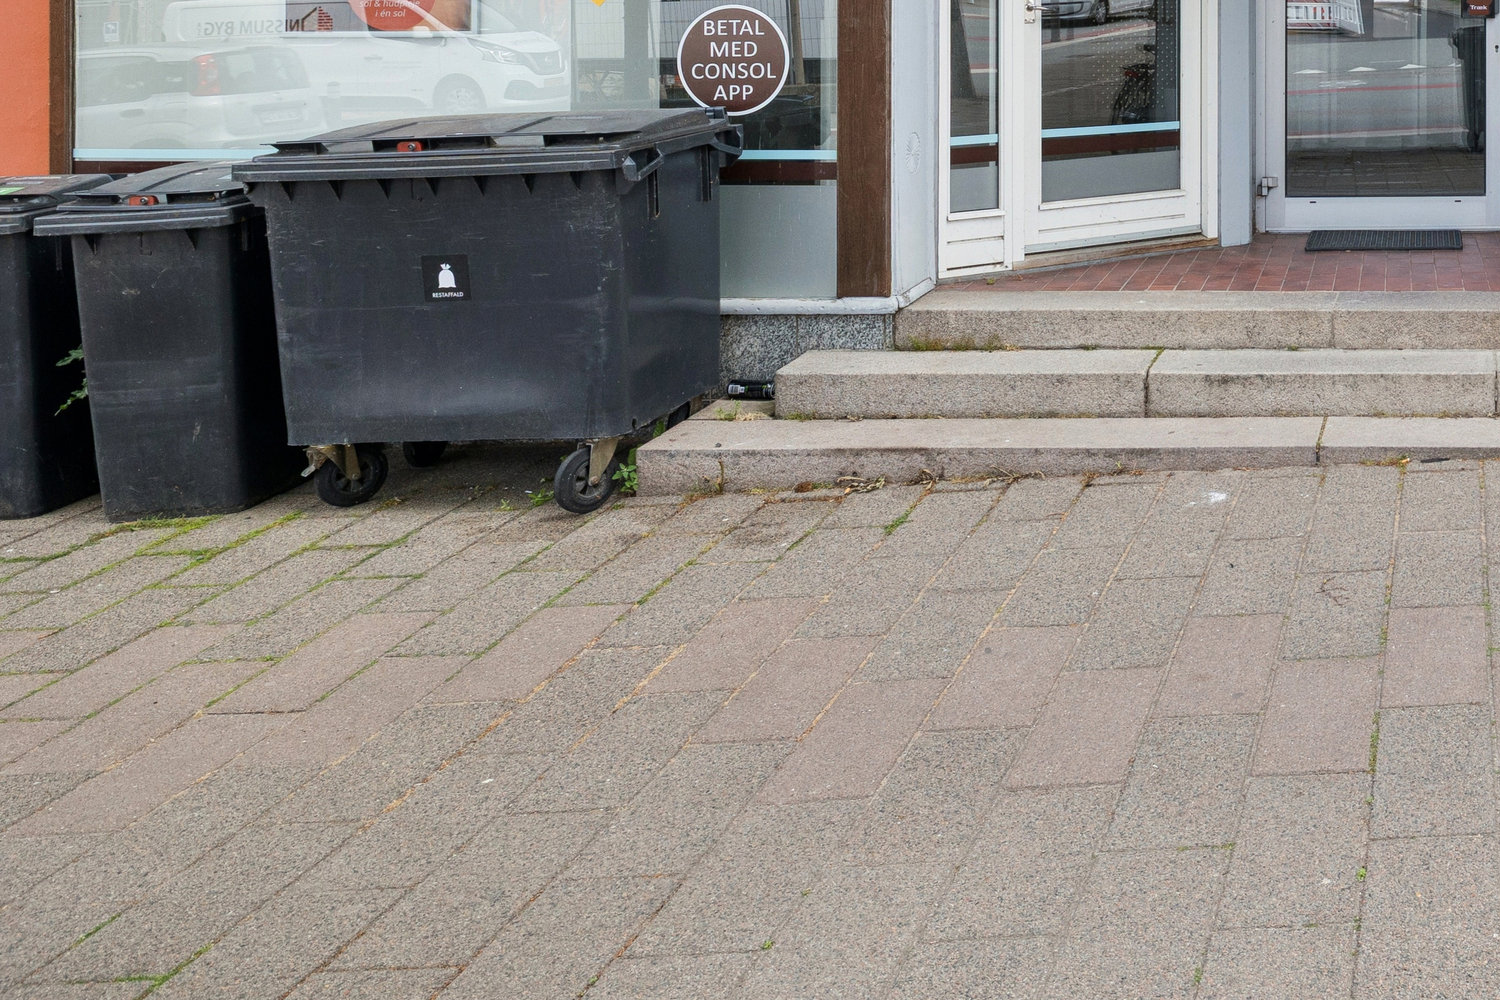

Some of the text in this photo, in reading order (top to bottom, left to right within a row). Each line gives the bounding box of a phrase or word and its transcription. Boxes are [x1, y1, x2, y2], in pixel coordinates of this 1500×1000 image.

[703, 19, 765, 36] BETAL
[710, 41, 758, 57] MED
[691, 63, 777, 79] CONSOL
[714, 85, 754, 101] APP
